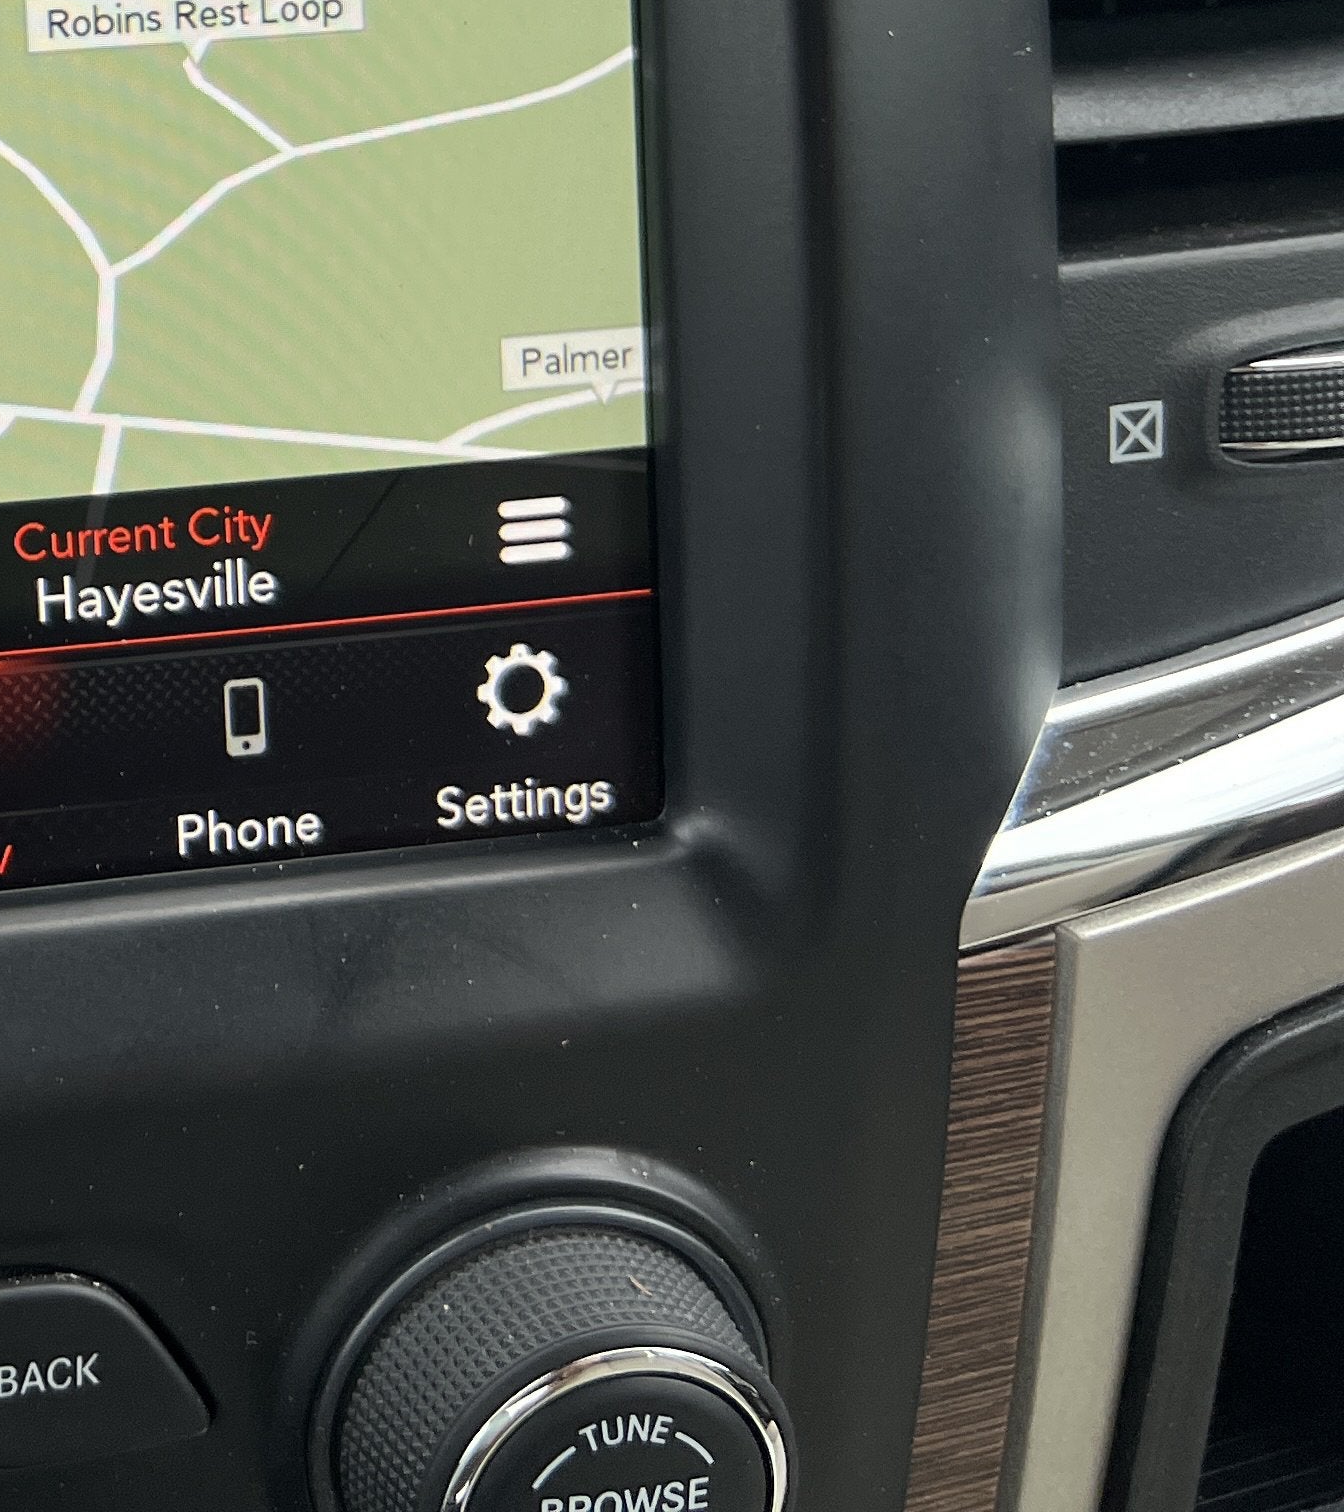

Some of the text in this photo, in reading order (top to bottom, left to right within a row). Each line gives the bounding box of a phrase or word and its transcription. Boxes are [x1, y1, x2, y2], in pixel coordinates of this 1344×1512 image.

[48, 5, 162, 39] Robins
[175, 0, 249, 30] Rest
[522, 343, 632, 377] Palmer
[13, 505, 272, 561] Current City
[35, 557, 278, 628] Hayesville
[436, 777, 613, 828] Settings
[177, 809, 323, 856] Phone
[578, 1413, 674, 1452] TUNE
